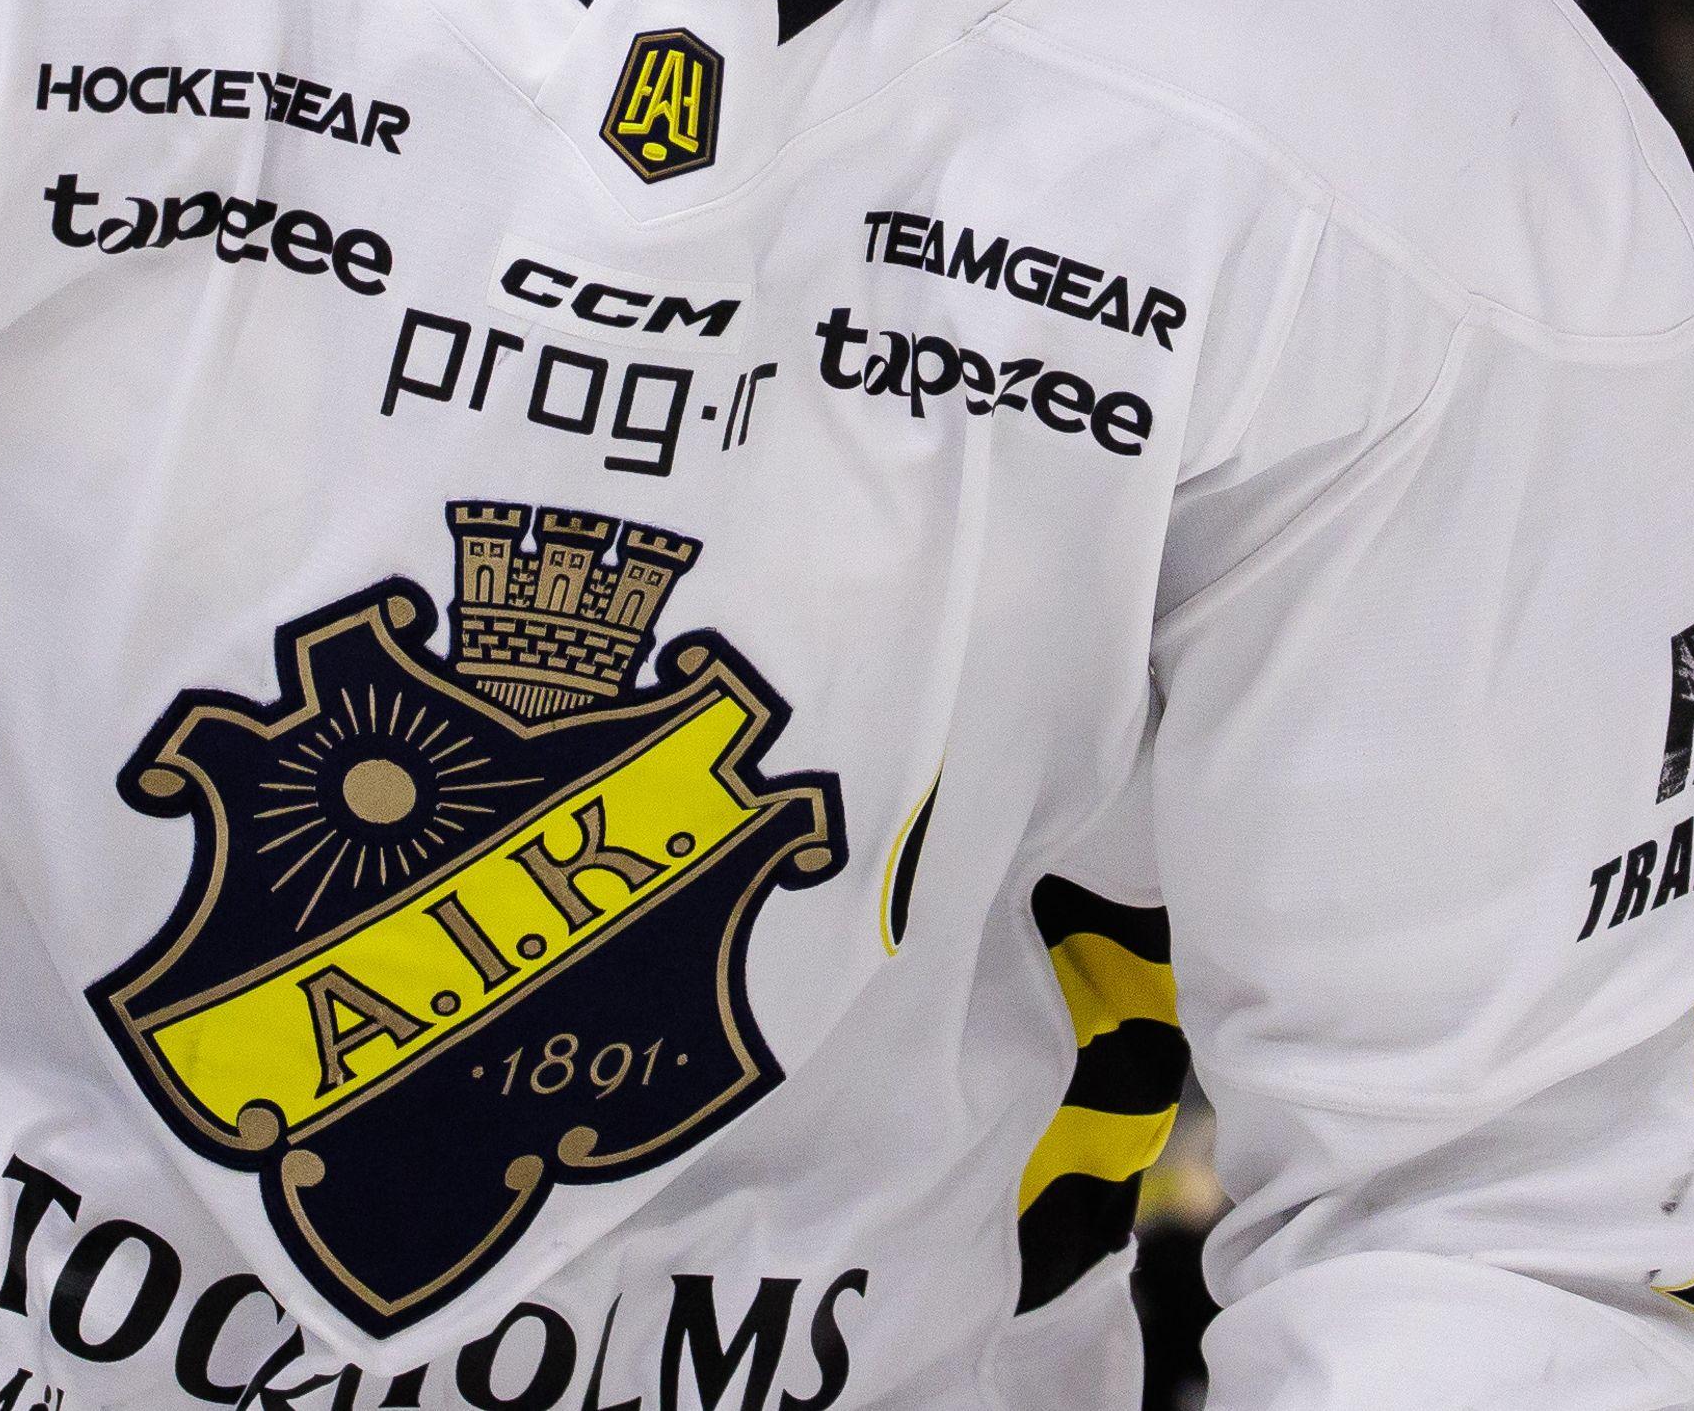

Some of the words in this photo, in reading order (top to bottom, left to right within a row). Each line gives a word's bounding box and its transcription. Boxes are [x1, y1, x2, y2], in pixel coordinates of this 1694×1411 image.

[500, 258, 742, 337] CCM
[864, 211, 1187, 352] TEAMGEAR
[815, 307, 1154, 456] tapezee
[296, 795, 696, 1099] A.I.K.
